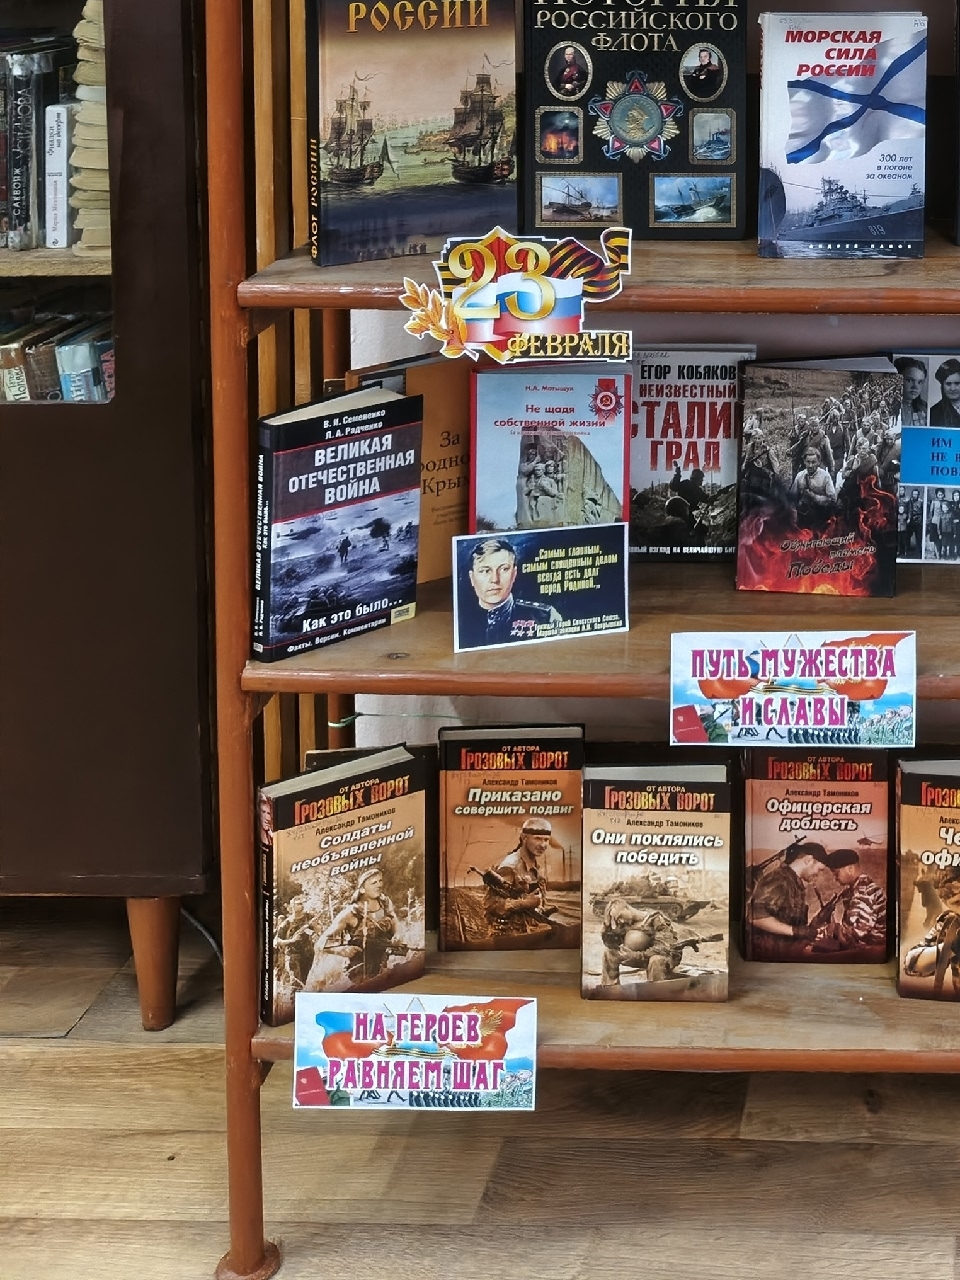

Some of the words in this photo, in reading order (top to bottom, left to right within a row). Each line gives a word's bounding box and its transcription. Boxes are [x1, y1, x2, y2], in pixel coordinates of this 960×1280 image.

[534, 6, 738, 32] РОССИЙСКОГО
[590, 31, 681, 53] ФЛОТА
[785, 29, 882, 45] МОРСКАЯ
[824, 47, 878, 62] СИЛА
[796, 63, 876, 78] РОССИИ
[879, 153, 897, 163] 300
[899, 155, 913, 163] лет
[884, 164, 913, 172] погоне
[13, 167, 22, 217] САКВОЯЖ
[448, 242, 557, 321] 23
[507, 332, 630, 357] ФЕВРАЛЯ
[640, 364, 672, 380] ЕГОР
[677, 364, 737, 380] КОБЯКОВ
[638, 381, 737, 399] НЕИЗВЕСТНЫЙ
[525, 404, 541, 414] Не
[544, 404, 575, 415] щадя
[494, 417, 565, 428] собственной
[568, 419, 606, 428] жизни
[439, 430, 460, 448] За
[931, 437, 952, 448] ИМ
[314, 433, 393, 467] ВЕЛИКАЯ
[650, 440, 721, 472] ГРАД
[288, 449, 415, 494] ОТЕЧЕСТВЕННАЯ
[324, 476, 381, 505] ВОЙНА
[691, 649, 748, 678] ПУТЬ
[761, 648, 897, 678] МУЖЕСТВА
[740, 697, 751, 726] И
[762, 697, 847, 726] СЛАВЫ
[294, 787, 366, 826] ГРОЗОВЫХ
[370, 775, 411, 805] ВОРОТ
[467, 787, 563, 804] Приказано
[604, 786, 671, 810] ГРОЗОВЫХ
[676, 792, 716, 811] ВОРОТ
[454, 803, 527, 816] совершить
[529, 803, 575, 817] подвиг
[766, 798, 872, 817] Офицерская
[626, 818, 664, 827] Александр
[665, 819, 703, 829] Тамоников
[778, 816, 859, 833] доблесть
[319, 819, 392, 850] Солдаты
[591, 829, 627, 845] Они
[630, 832, 725, 848] поклялись
[290, 826, 415, 874] необъявленной
[615, 849, 700, 867] победить
[330, 852, 382, 877] войны
[354, 1013, 386, 1041] НА
[396, 1014, 480, 1042] ГЕРОЕВ
[327, 1059, 444, 1090] РАВНЯЕМ
[451, 1061, 504, 1090] ШАГ
